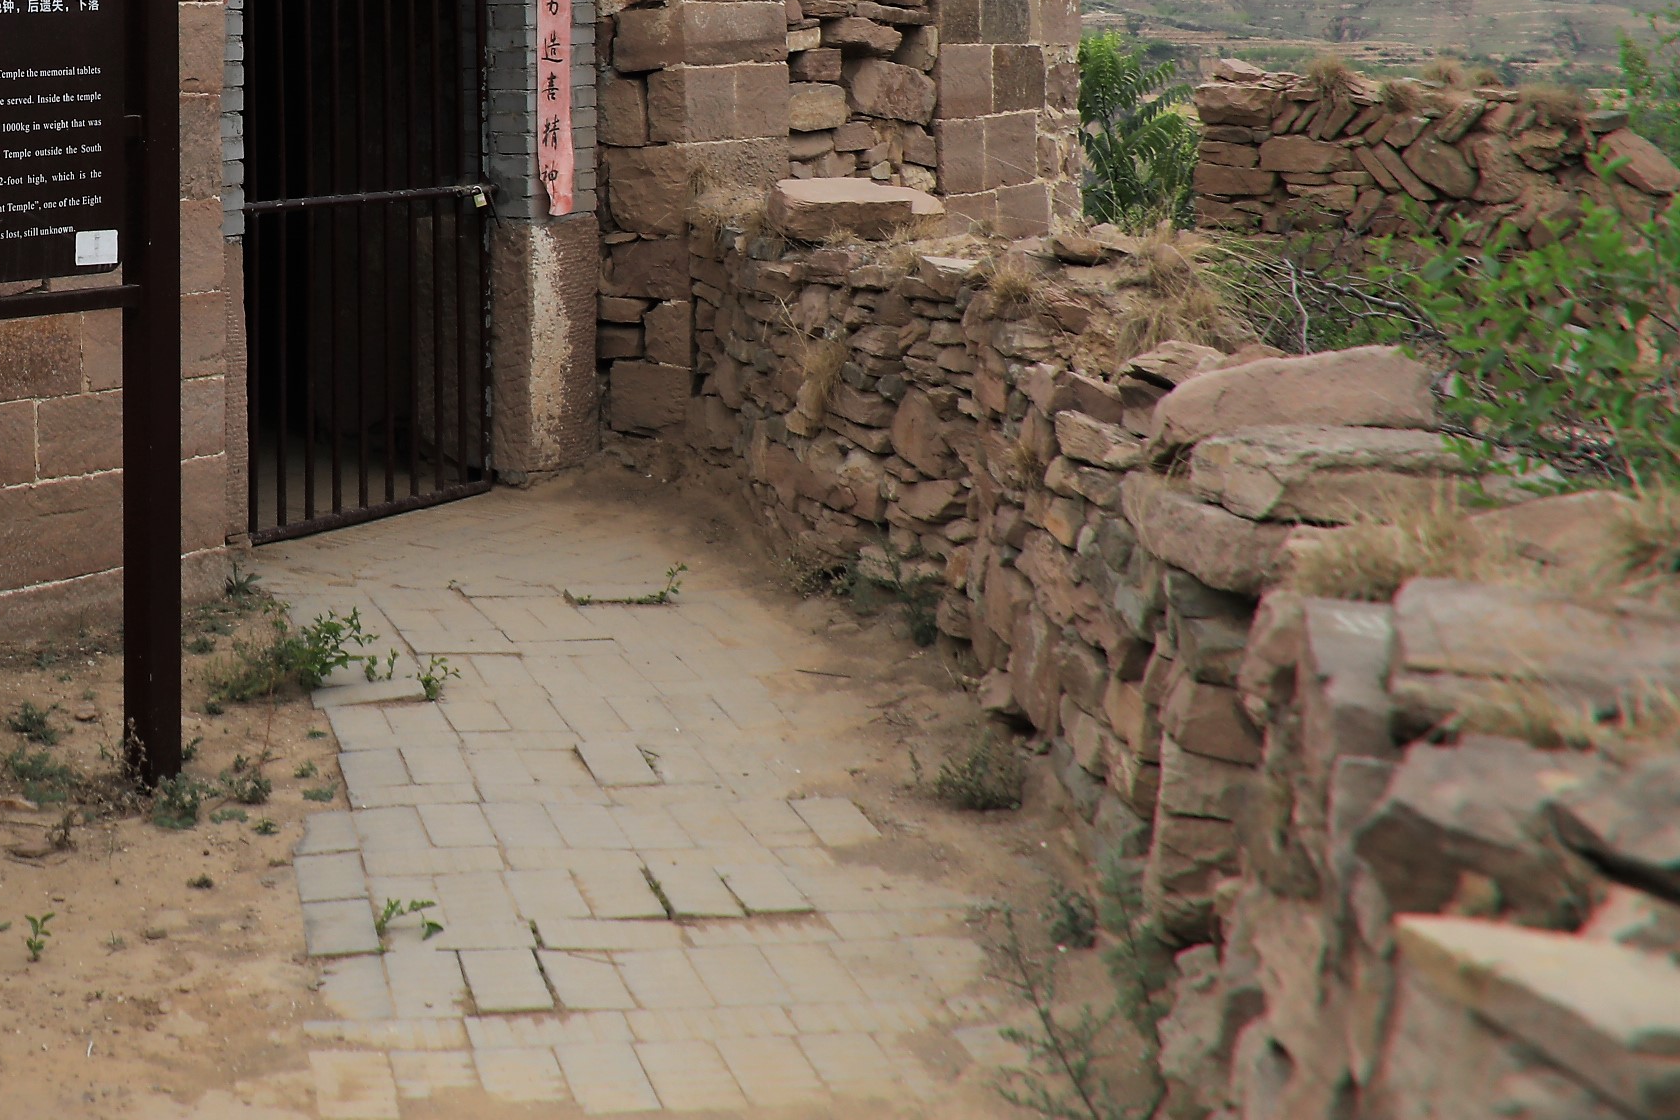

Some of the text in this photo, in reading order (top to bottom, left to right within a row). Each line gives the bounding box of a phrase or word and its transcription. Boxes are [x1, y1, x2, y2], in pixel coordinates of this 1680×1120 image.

[26, 68, 39, 77] the
[39, 67, 76, 76] memorial
[76, 66, 101, 74] tablets
[6, 95, 35, 105] served.
[37, 94, 61, 103] Inside
[62, 93, 75, 101] the
[76, 92, 102, 102] temple
[2, 122, 31, 133] 1000kg
[42, 120, 69, 131] weight
[71, 119, 86, 127] that
[2, 149, 32, 160] Temple
[34, 147, 63, 156] outside
[65, 146, 78, 154] the
[80, 143, 102, 153] South
[27, 174, 48, 185] high,
[51, 172, 75, 181] which
[90, 170, 102, 178] the
[58, 198, 68, 207] of
[68, 198, 80, 206] the
[82, 195, 102, 206] Eight
[5, 230, 23, 238] lost,
[23, 227, 39, 237] still
[39, 225, 76, 236] unknown.
